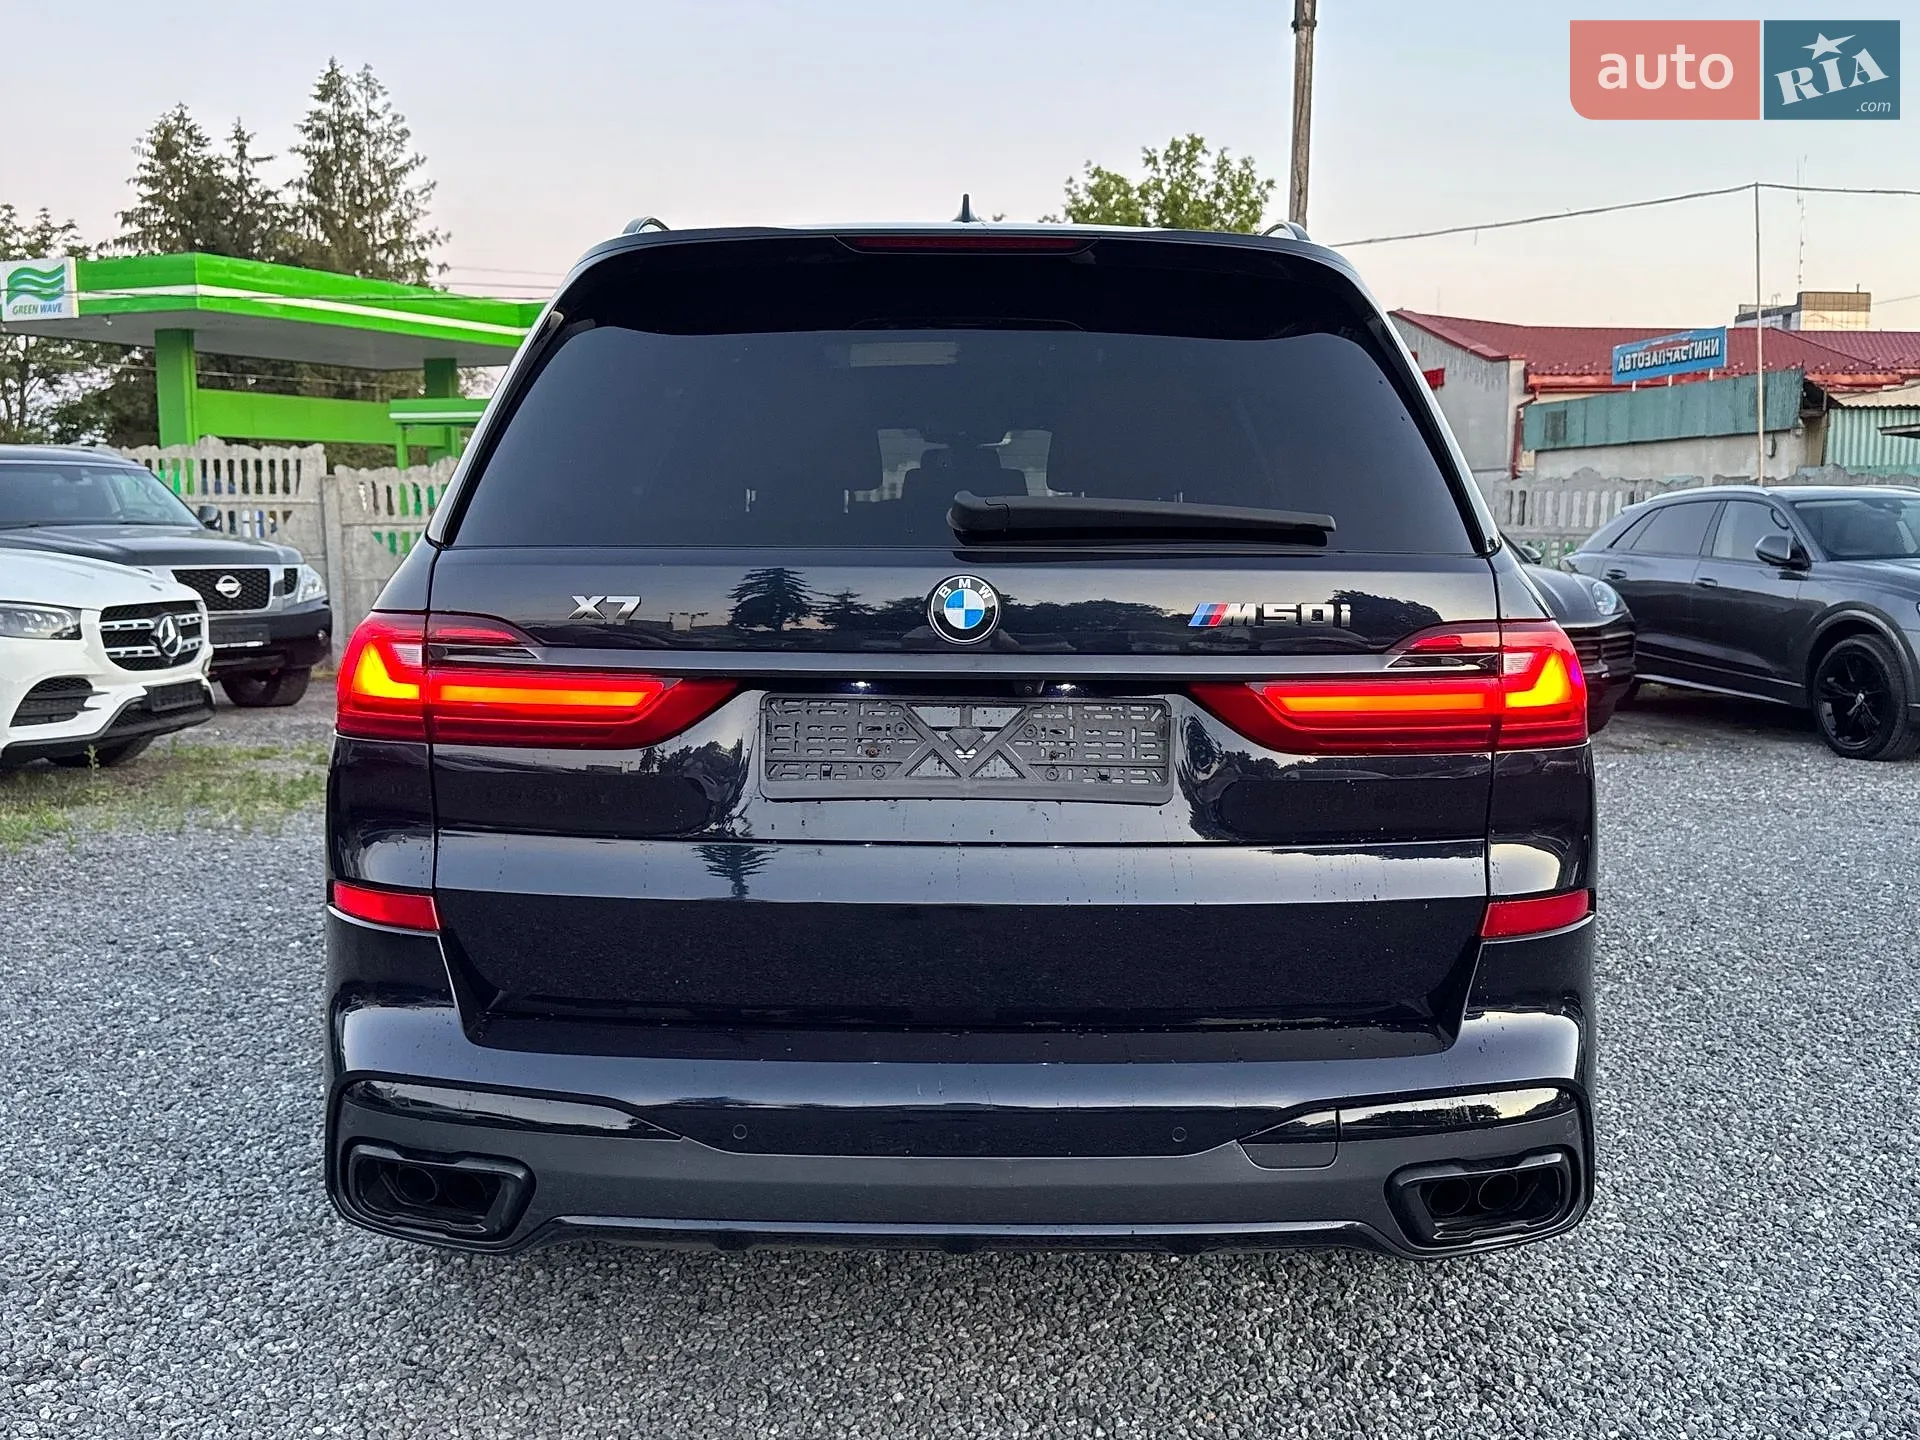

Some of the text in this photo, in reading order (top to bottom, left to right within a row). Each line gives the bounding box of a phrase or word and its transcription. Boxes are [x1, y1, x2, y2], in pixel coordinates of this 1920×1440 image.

[12, 303, 63, 315] GREEN WAVE
[938, 578, 992, 599] BMW
[567, 595, 641, 620] X7
